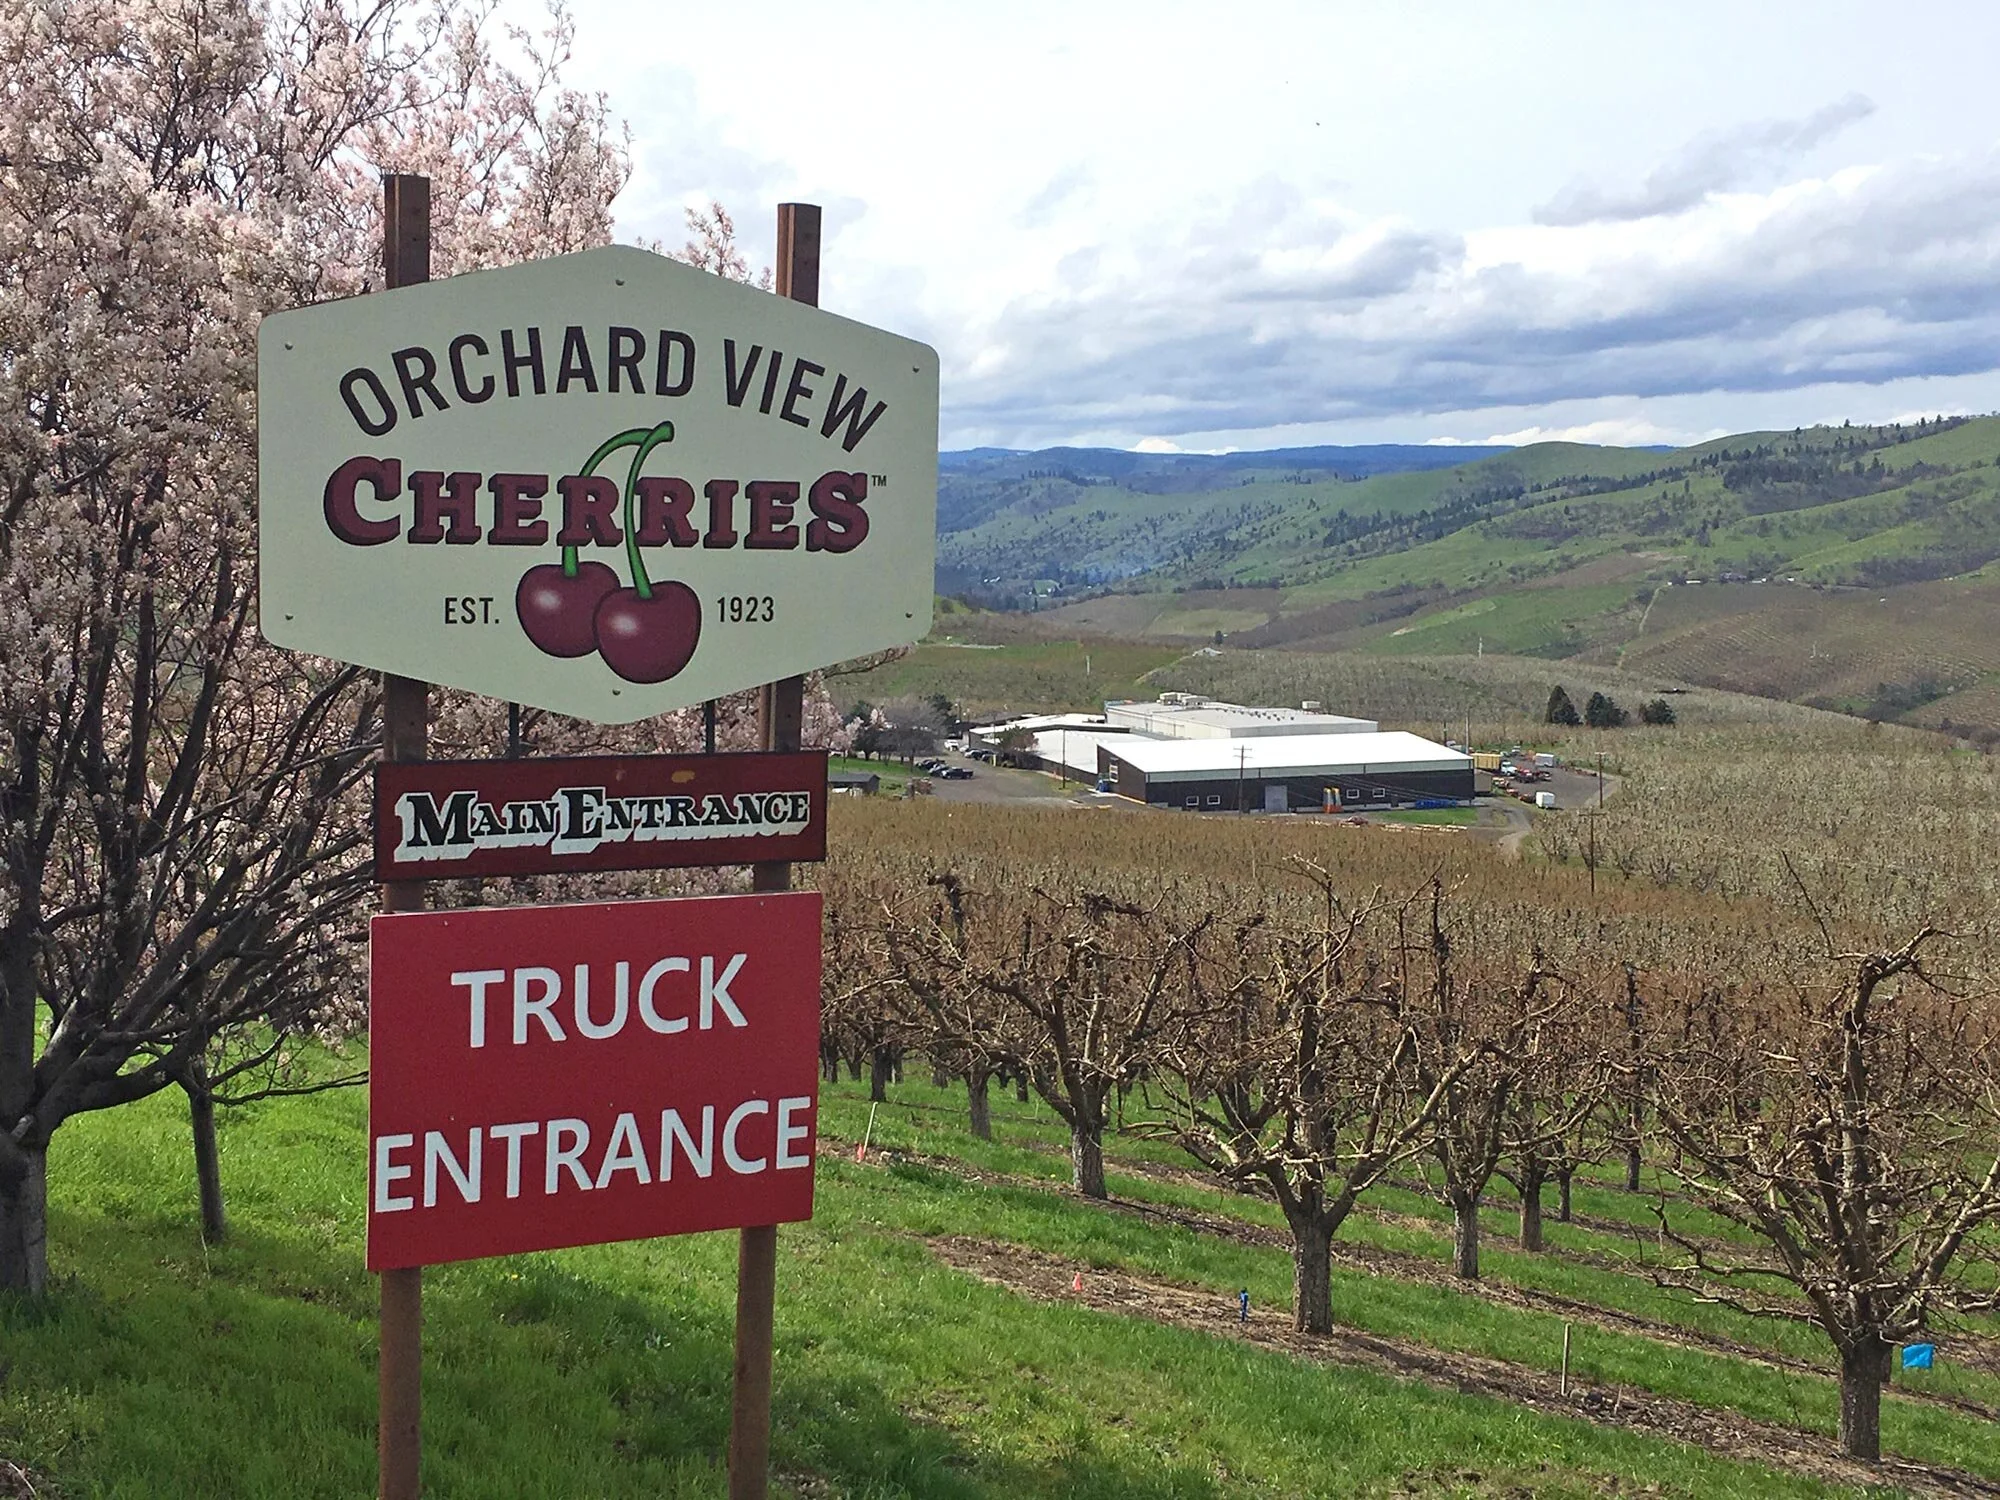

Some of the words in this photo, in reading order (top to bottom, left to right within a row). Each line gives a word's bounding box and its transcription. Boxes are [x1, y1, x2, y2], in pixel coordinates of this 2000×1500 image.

[339, 325, 696, 437] ORCHARD
[723, 338, 888, 453] VIEW
[323, 455, 871, 553] CHERRIES
[444, 596, 500, 625] EST.
[717, 596, 775, 623] 1923
[394, 789, 560, 862] MAIN
[554, 786, 811, 855] ENTRANCE
[451, 953, 748, 1048] TRUCK
[374, 1096, 811, 1213] ENTRANCE
